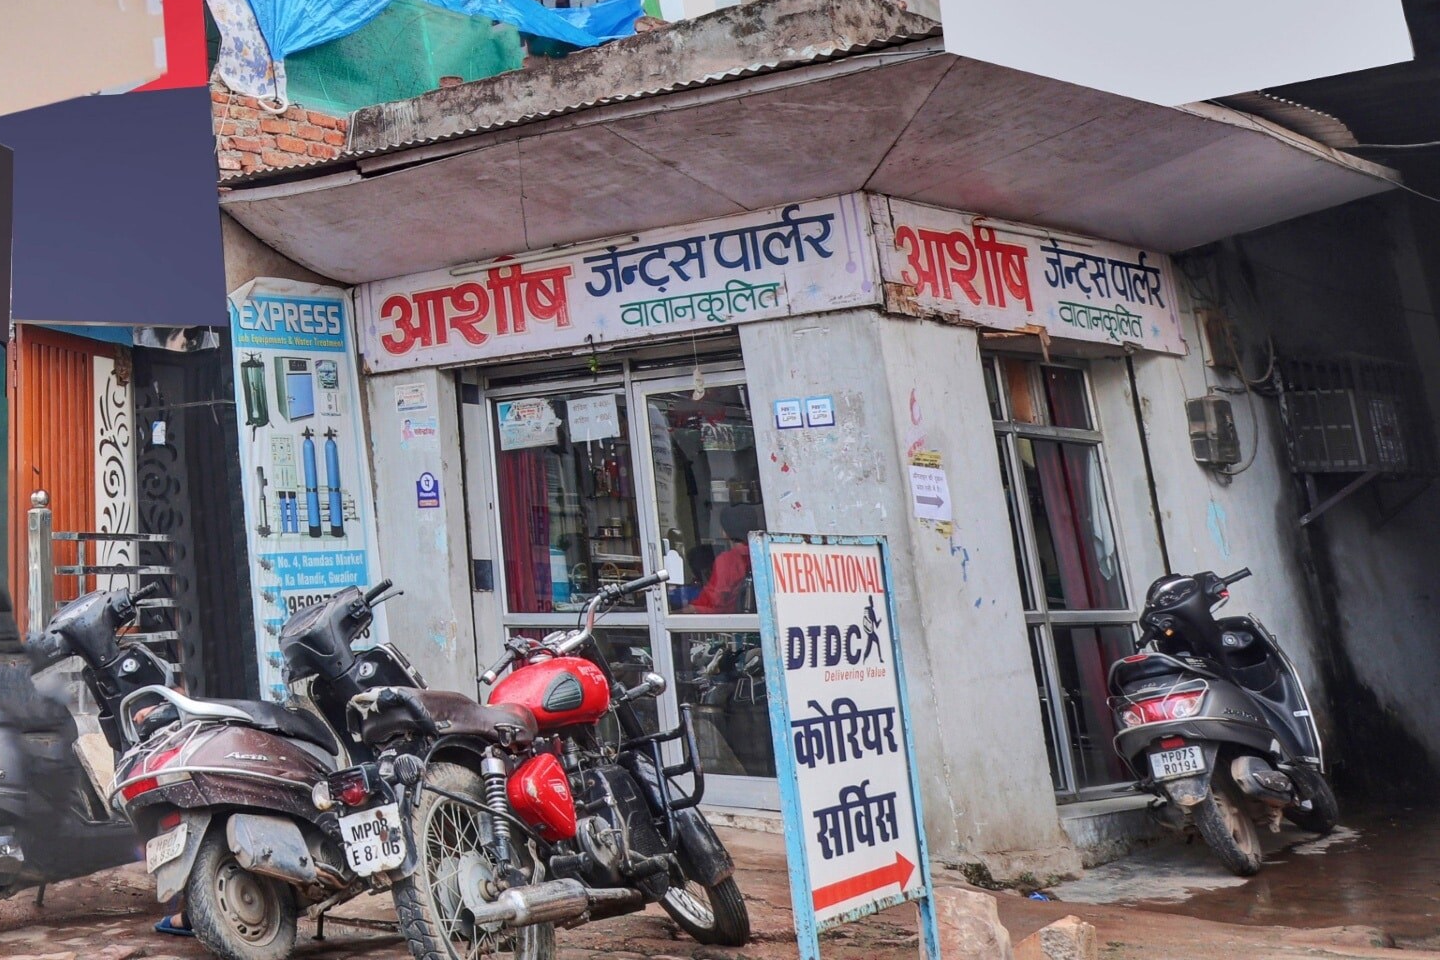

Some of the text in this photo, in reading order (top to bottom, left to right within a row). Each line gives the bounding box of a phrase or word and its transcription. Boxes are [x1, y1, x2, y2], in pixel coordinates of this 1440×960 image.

[379, 256, 573, 354] आशीष
[710, 204, 834, 271] पार्लर
[896, 217, 1034, 312] आशीष
[1108, 251, 1165, 308] पार्लर
[240, 300, 340, 335] EXPRESS
[278, 556, 292, 569] No.
[302, 553, 333, 567] Ramdas
[336, 553, 363, 566] Market
[328, 572, 358, 583] Gwalior
[785, 624, 862, 670] DTDC
[824, 666, 886, 682] Delivering Value
[791, 697, 898, 769] कोरियर
[1161, 748, 1195, 763] MP07S
[351, 818, 389, 841] MP08
[813, 779, 899, 860] सर्विस
